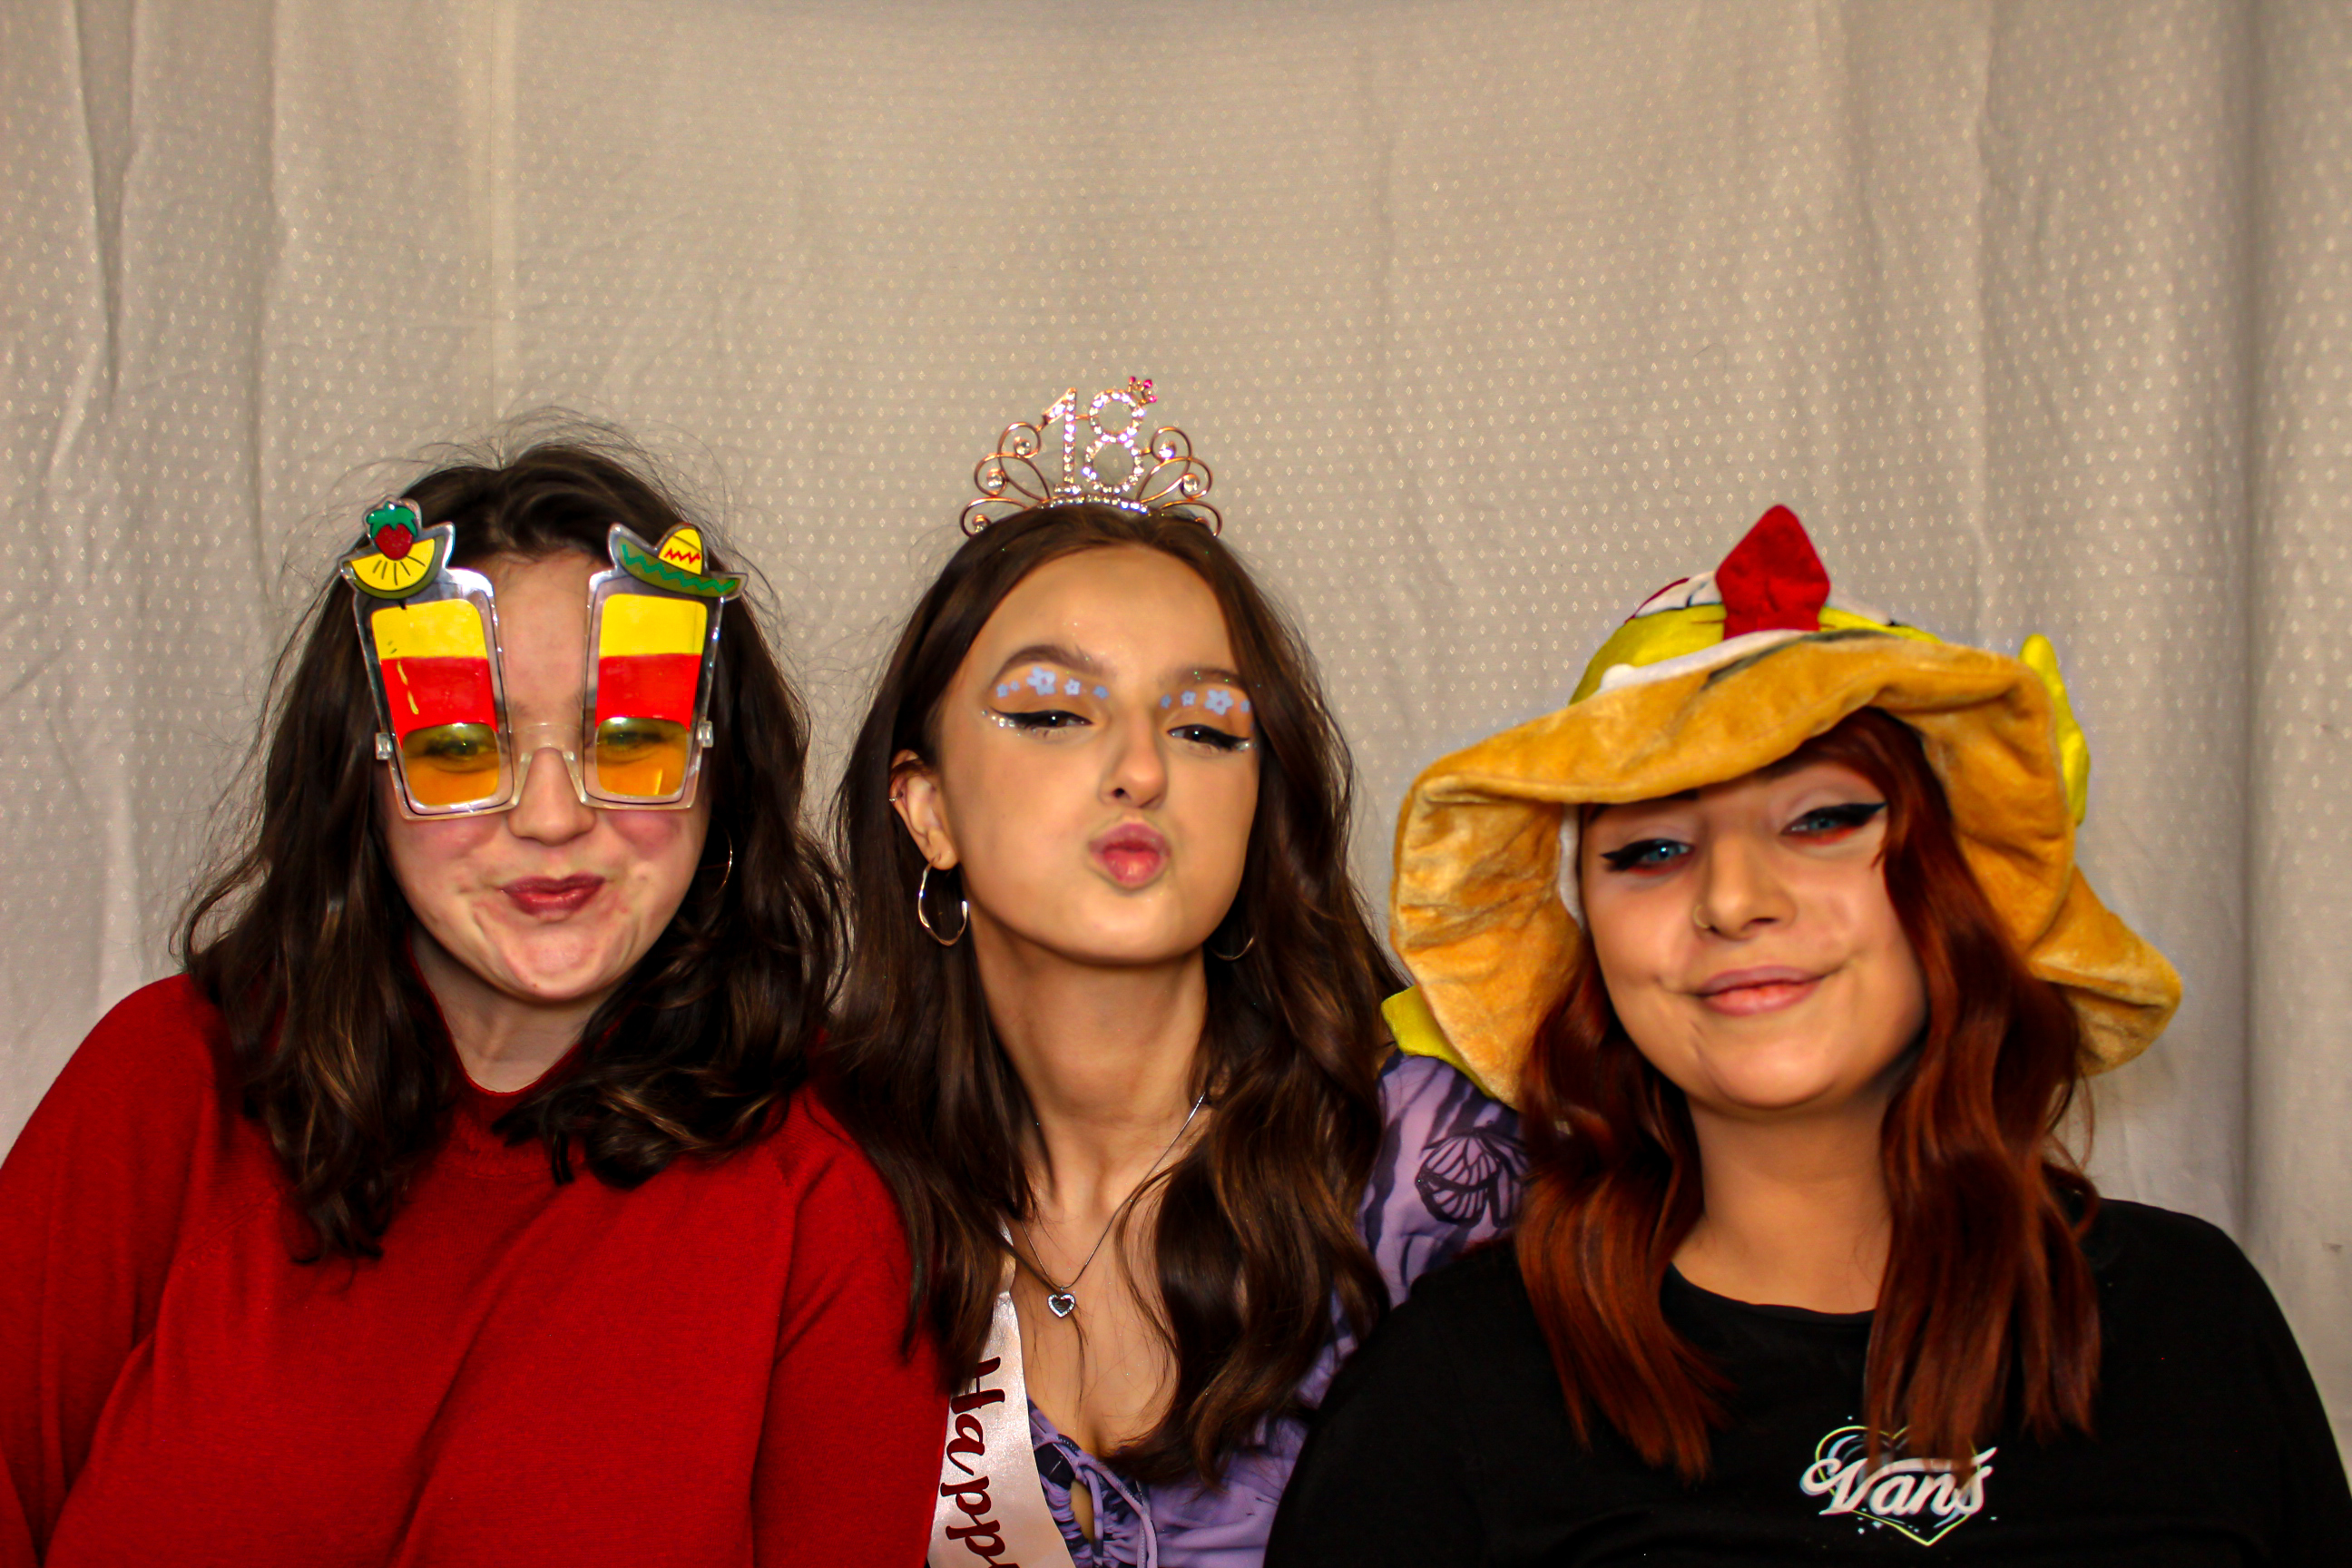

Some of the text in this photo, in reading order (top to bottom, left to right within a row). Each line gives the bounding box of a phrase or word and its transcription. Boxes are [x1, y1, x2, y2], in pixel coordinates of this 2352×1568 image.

[1042, 387, 1143, 495] 18
[939, 1356, 1021, 1568] Happ
[1799, 1446, 1998, 1515] Vans
